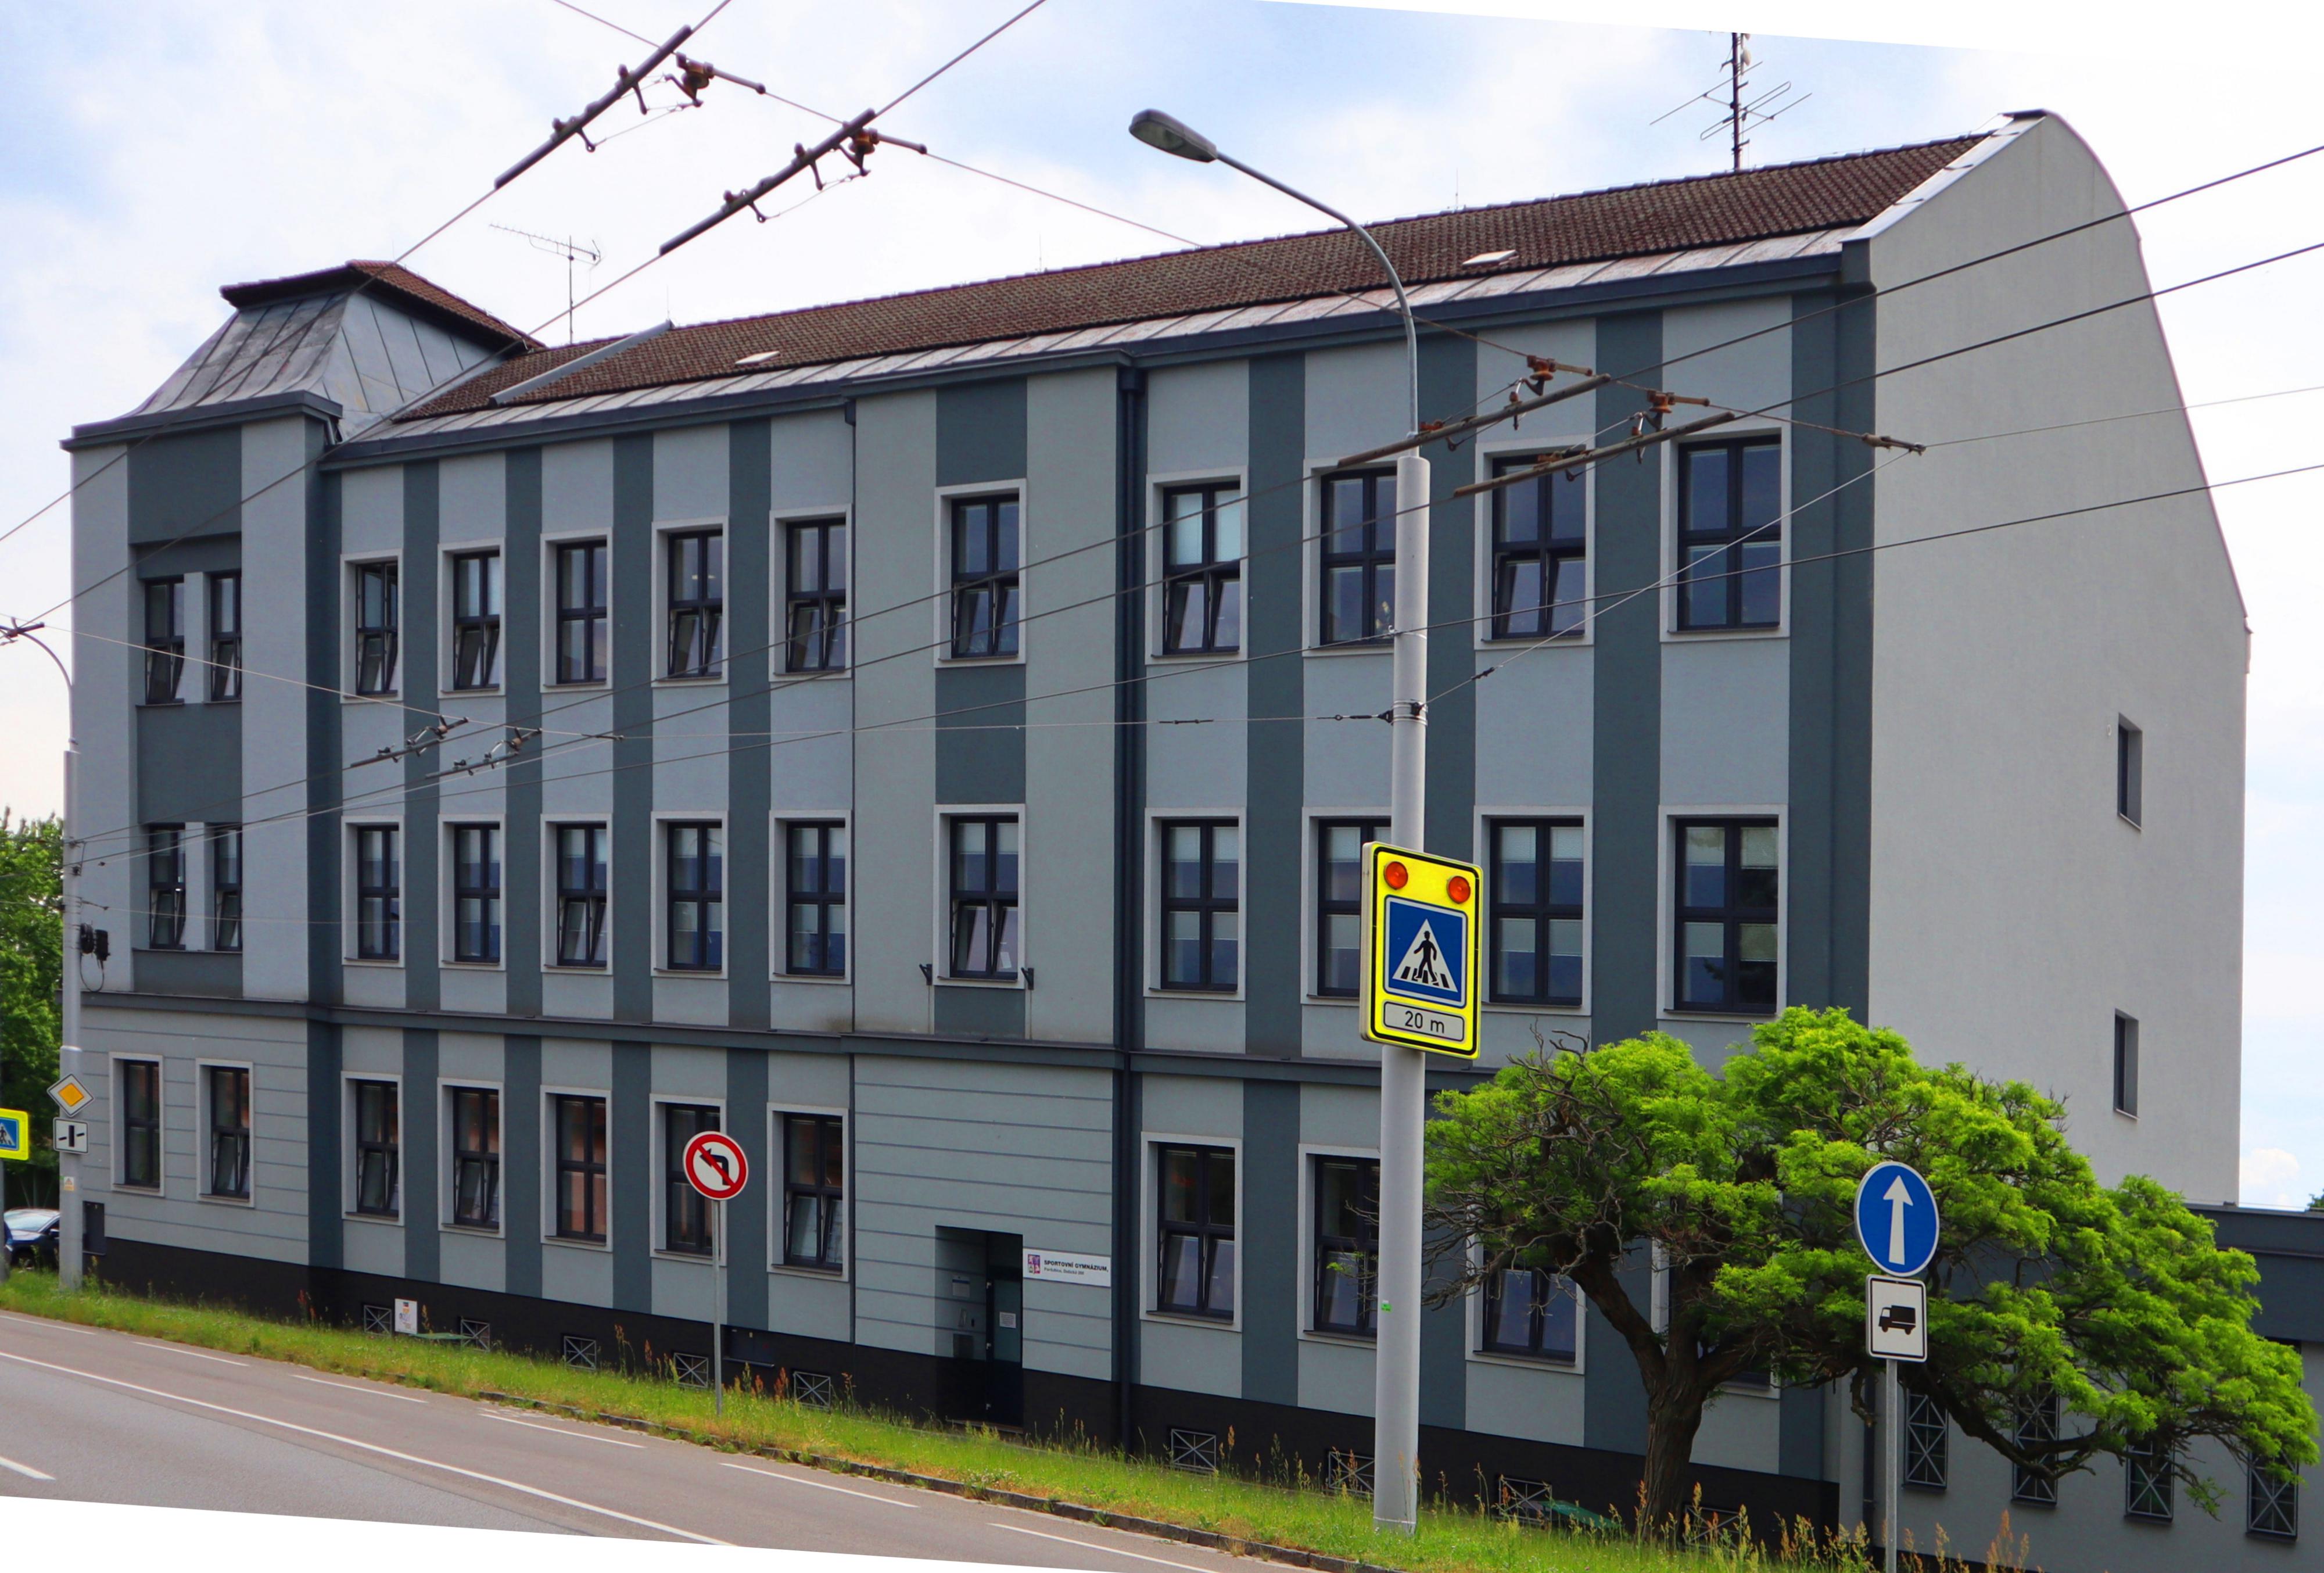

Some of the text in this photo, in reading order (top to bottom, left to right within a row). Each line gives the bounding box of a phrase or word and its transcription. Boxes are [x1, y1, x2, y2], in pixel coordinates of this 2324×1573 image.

[1405, 1011, 1444, 1034] 20 m
[1044, 1260, 1074, 1268] SPORTOVNÍ
